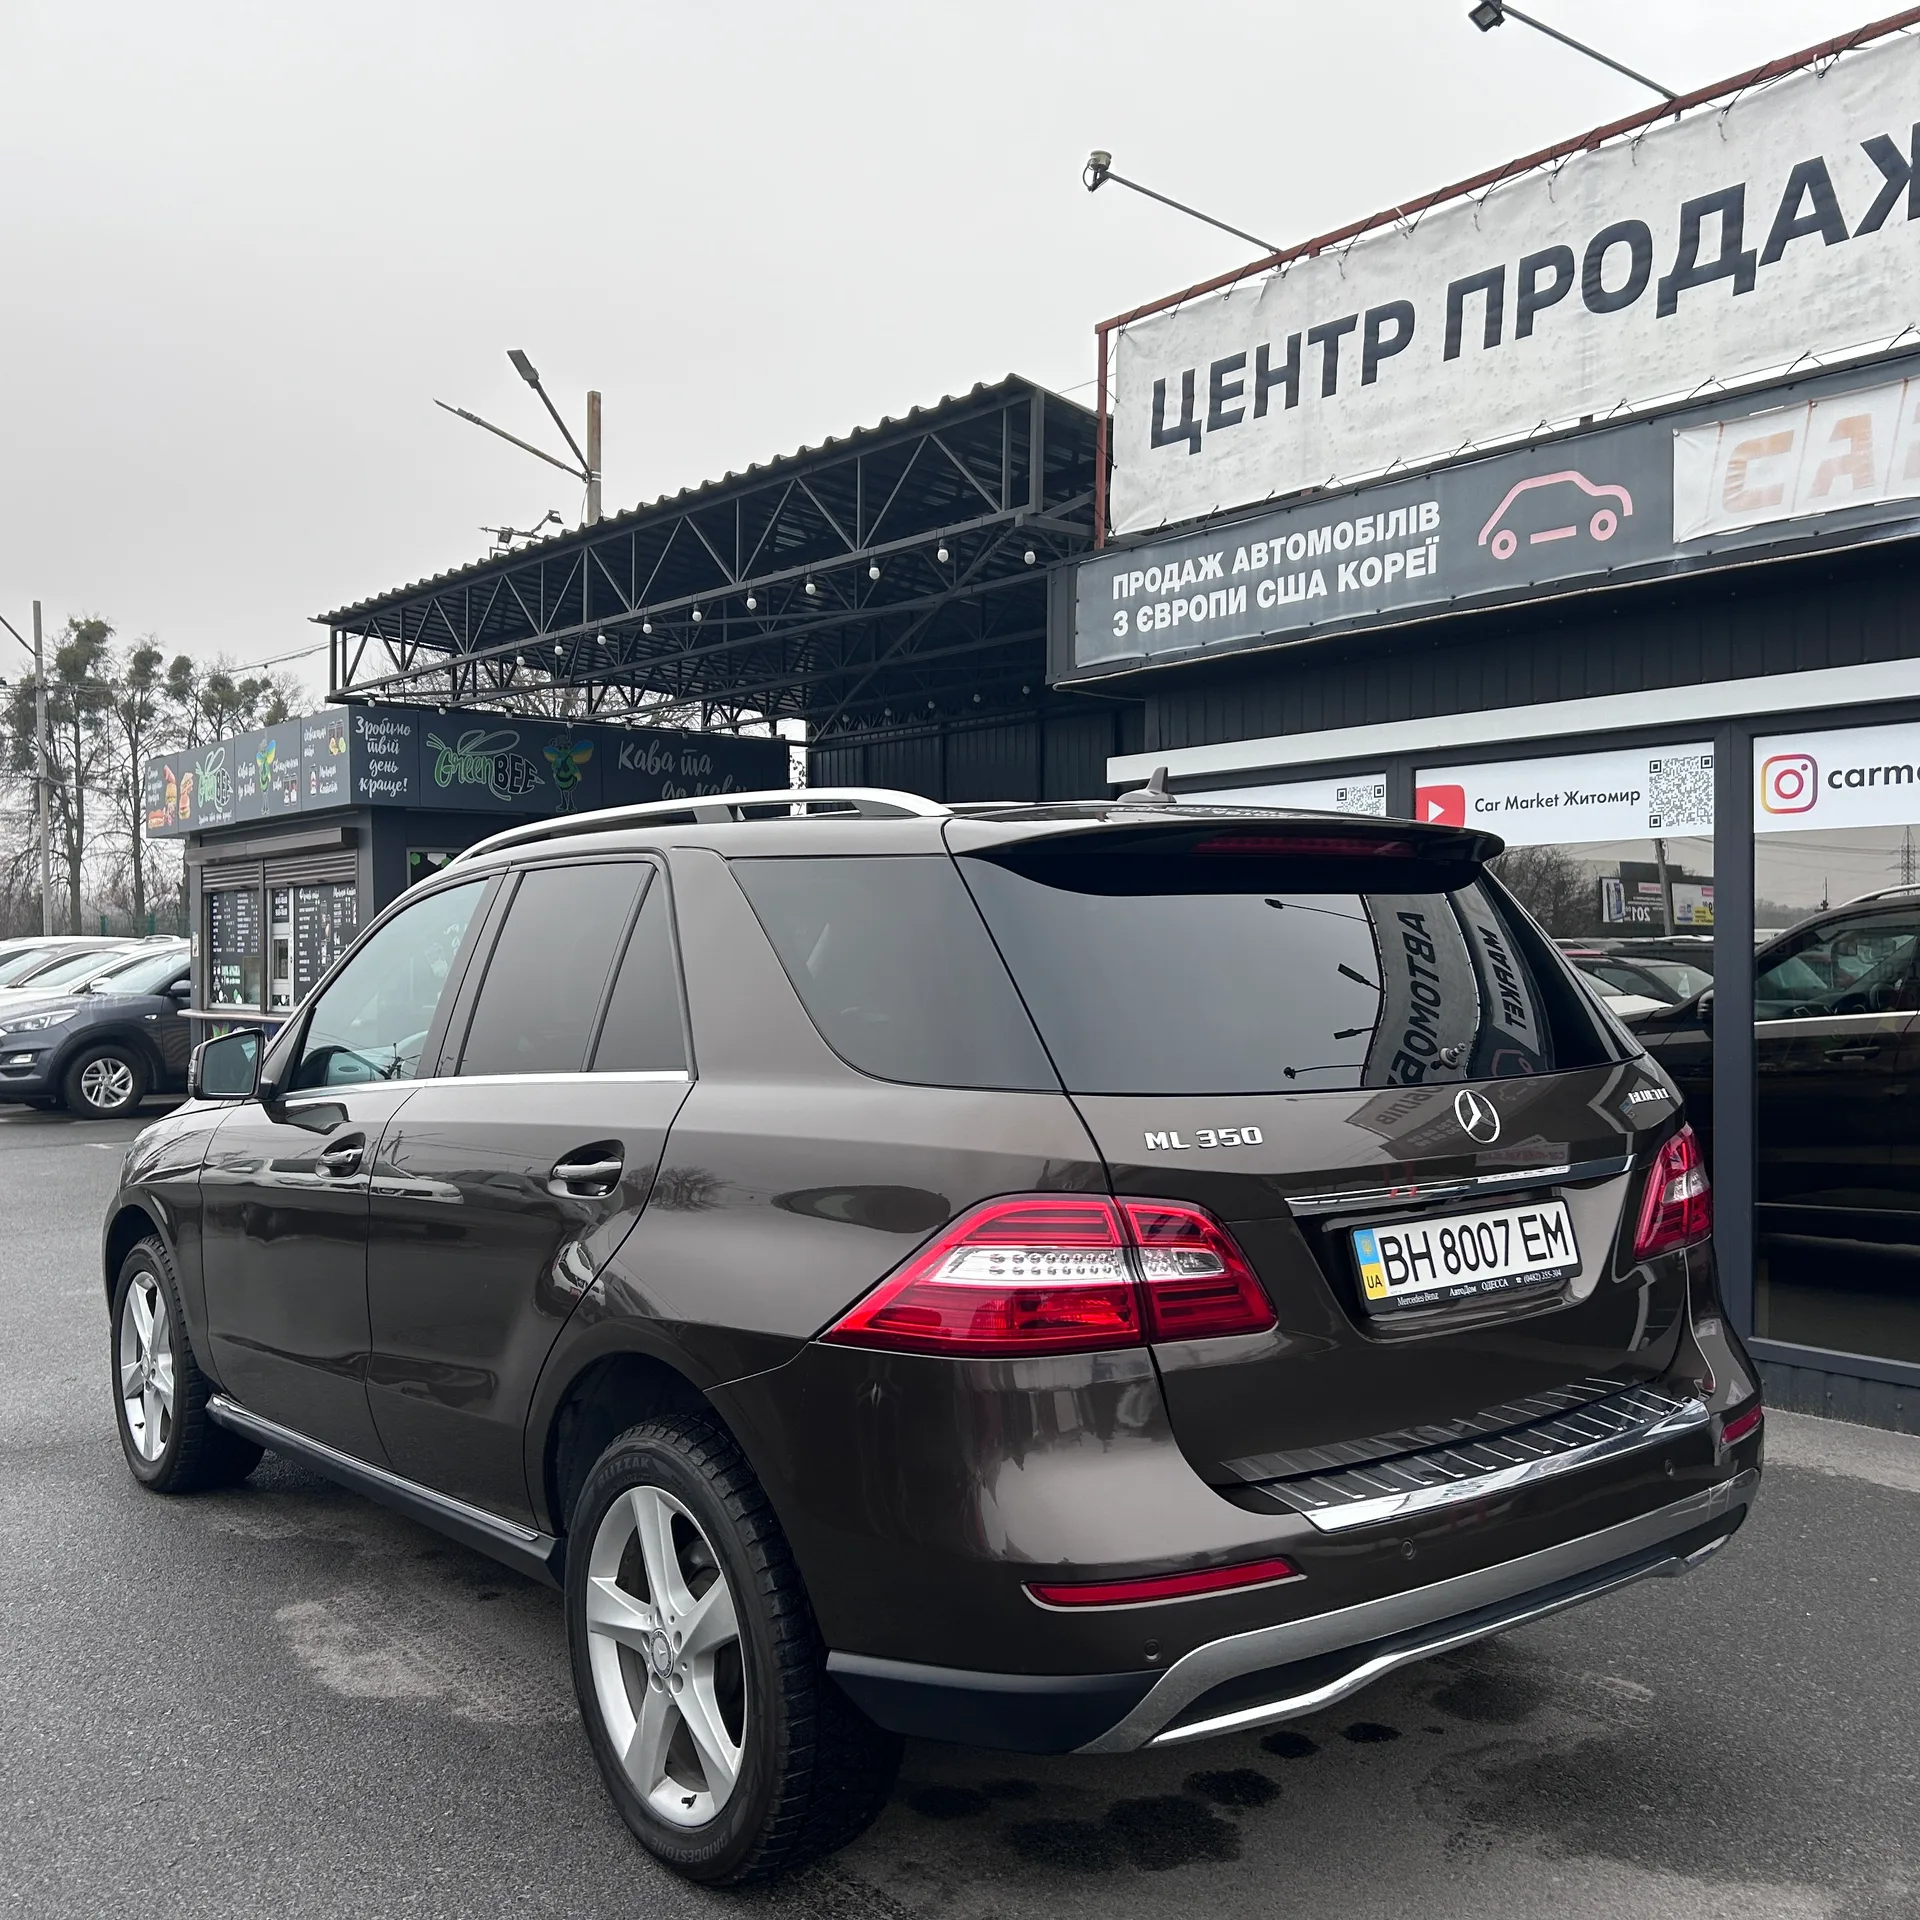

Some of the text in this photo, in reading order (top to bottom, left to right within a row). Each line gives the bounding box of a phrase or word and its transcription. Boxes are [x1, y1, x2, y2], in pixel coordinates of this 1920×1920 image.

[1150, 299, 1416, 456] ЦЕНТР
[1721, 402, 1920, 514] CA
[1112, 500, 1441, 600] ПРОДАЖ АВТОМОБІЛІВ
[1112, 535, 1441, 637] З ЄВРОПИ США КОРЕЇ
[355, 715, 411, 741] Зробимо
[367, 737, 400, 755] твій
[618, 738, 714, 777] Кава та
[368, 758, 399, 775] день
[1827, 764, 1920, 790] carm
[359, 777, 408, 799] краще!
[1475, 790, 1641, 813] Car Market Житомир
[1143, 1126, 1264, 1150] ML 350
[1378, 1210, 1571, 1287] BH 8007 EM
[1366, 1274, 1384, 1290] UA
[1481, 1277, 1510, 1291] ОДЕССА
[650, 1830, 728, 1864] BRIDGESTONE
